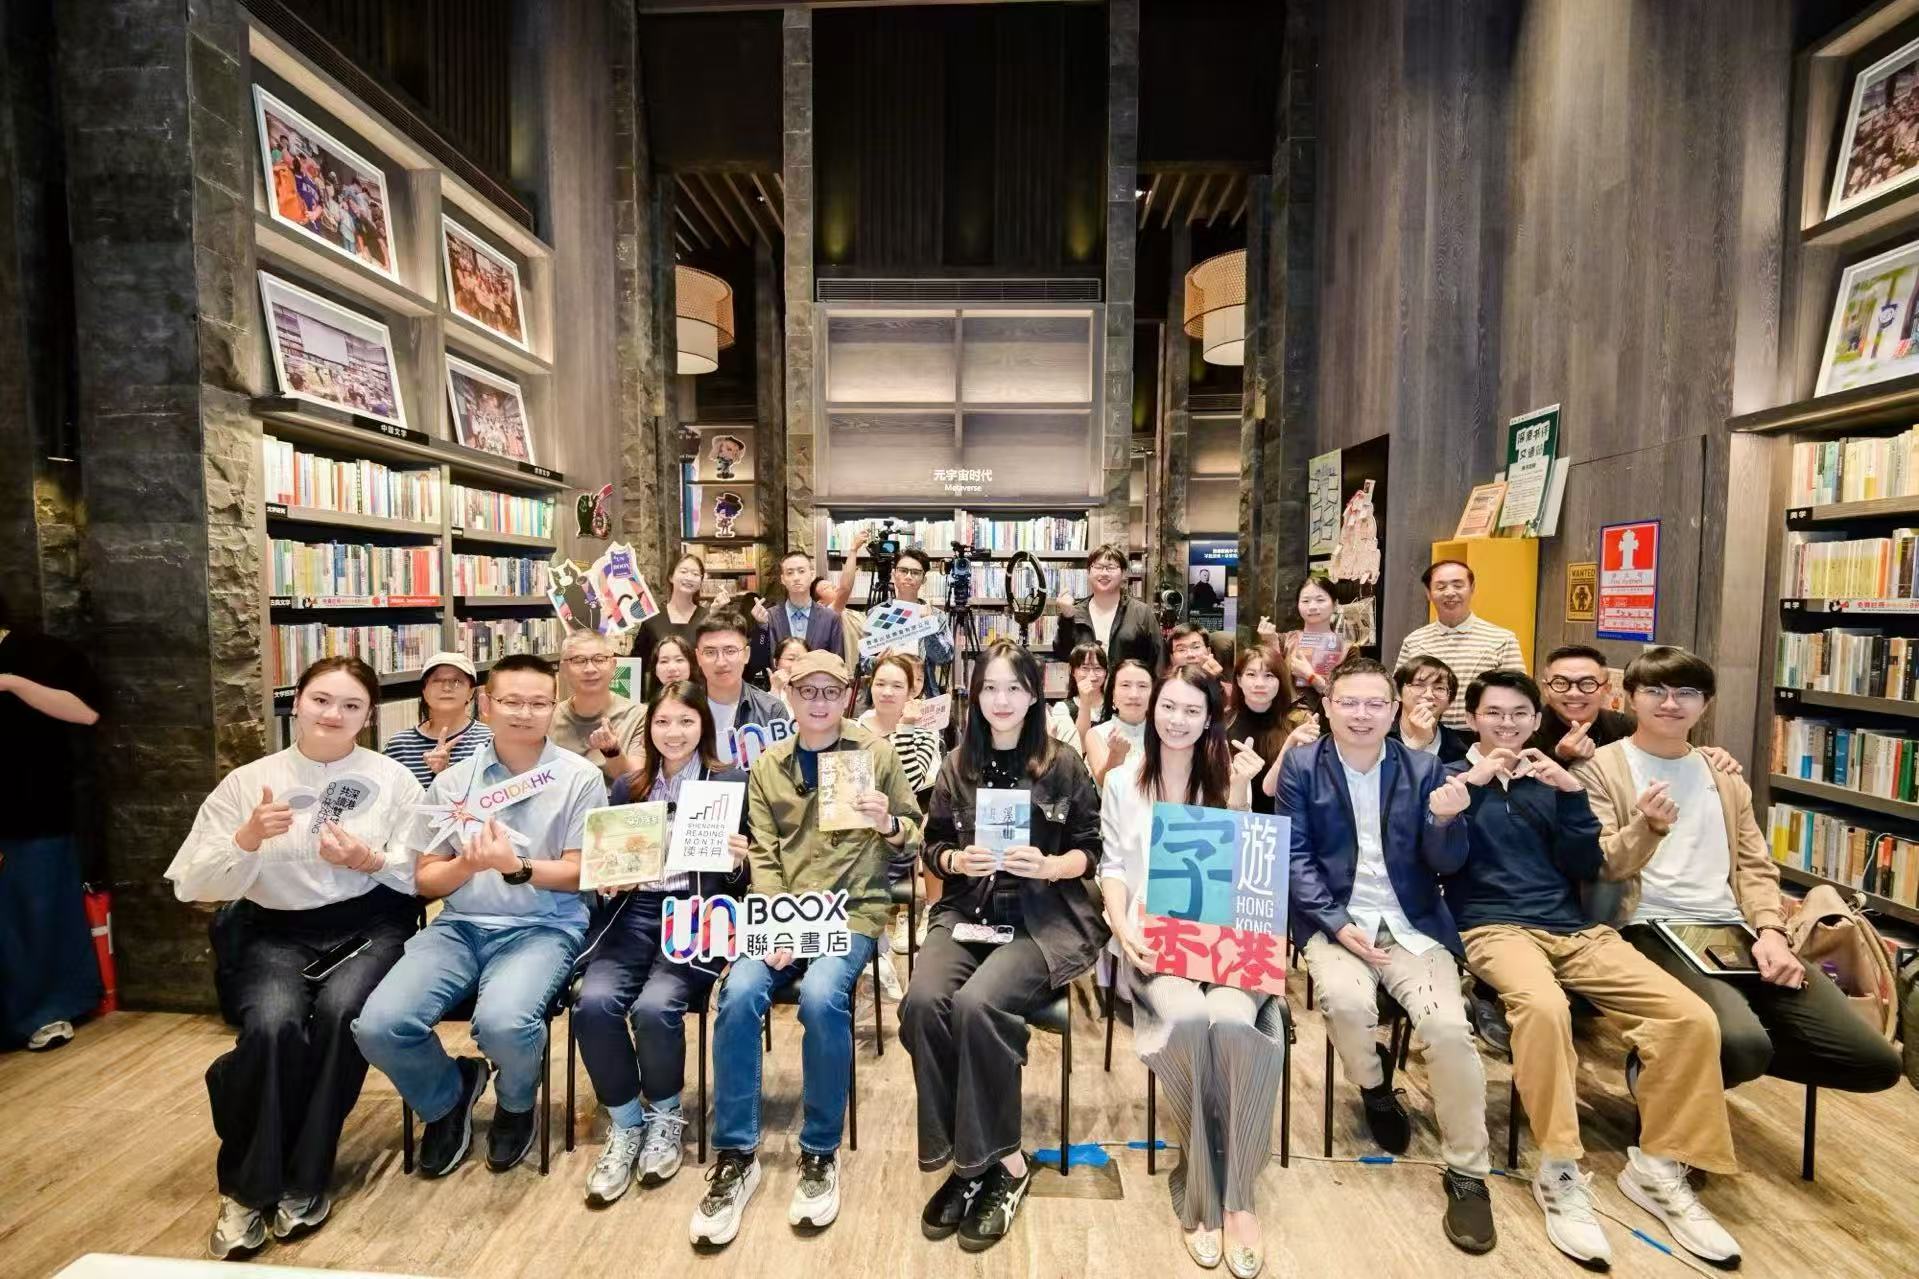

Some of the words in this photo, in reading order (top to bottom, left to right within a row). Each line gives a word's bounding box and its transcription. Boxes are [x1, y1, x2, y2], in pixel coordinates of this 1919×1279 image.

[934, 469, 993, 482] 元宇宙时代
[1571, 569, 1596, 577] WANTED
[480, 769, 555, 808] CCIDAHK
[747, 893, 847, 925] BOOX
[1236, 896, 1274, 918] HONG
[1235, 917, 1272, 937] KONG
[747, 930, 848, 956] 聯合書店
